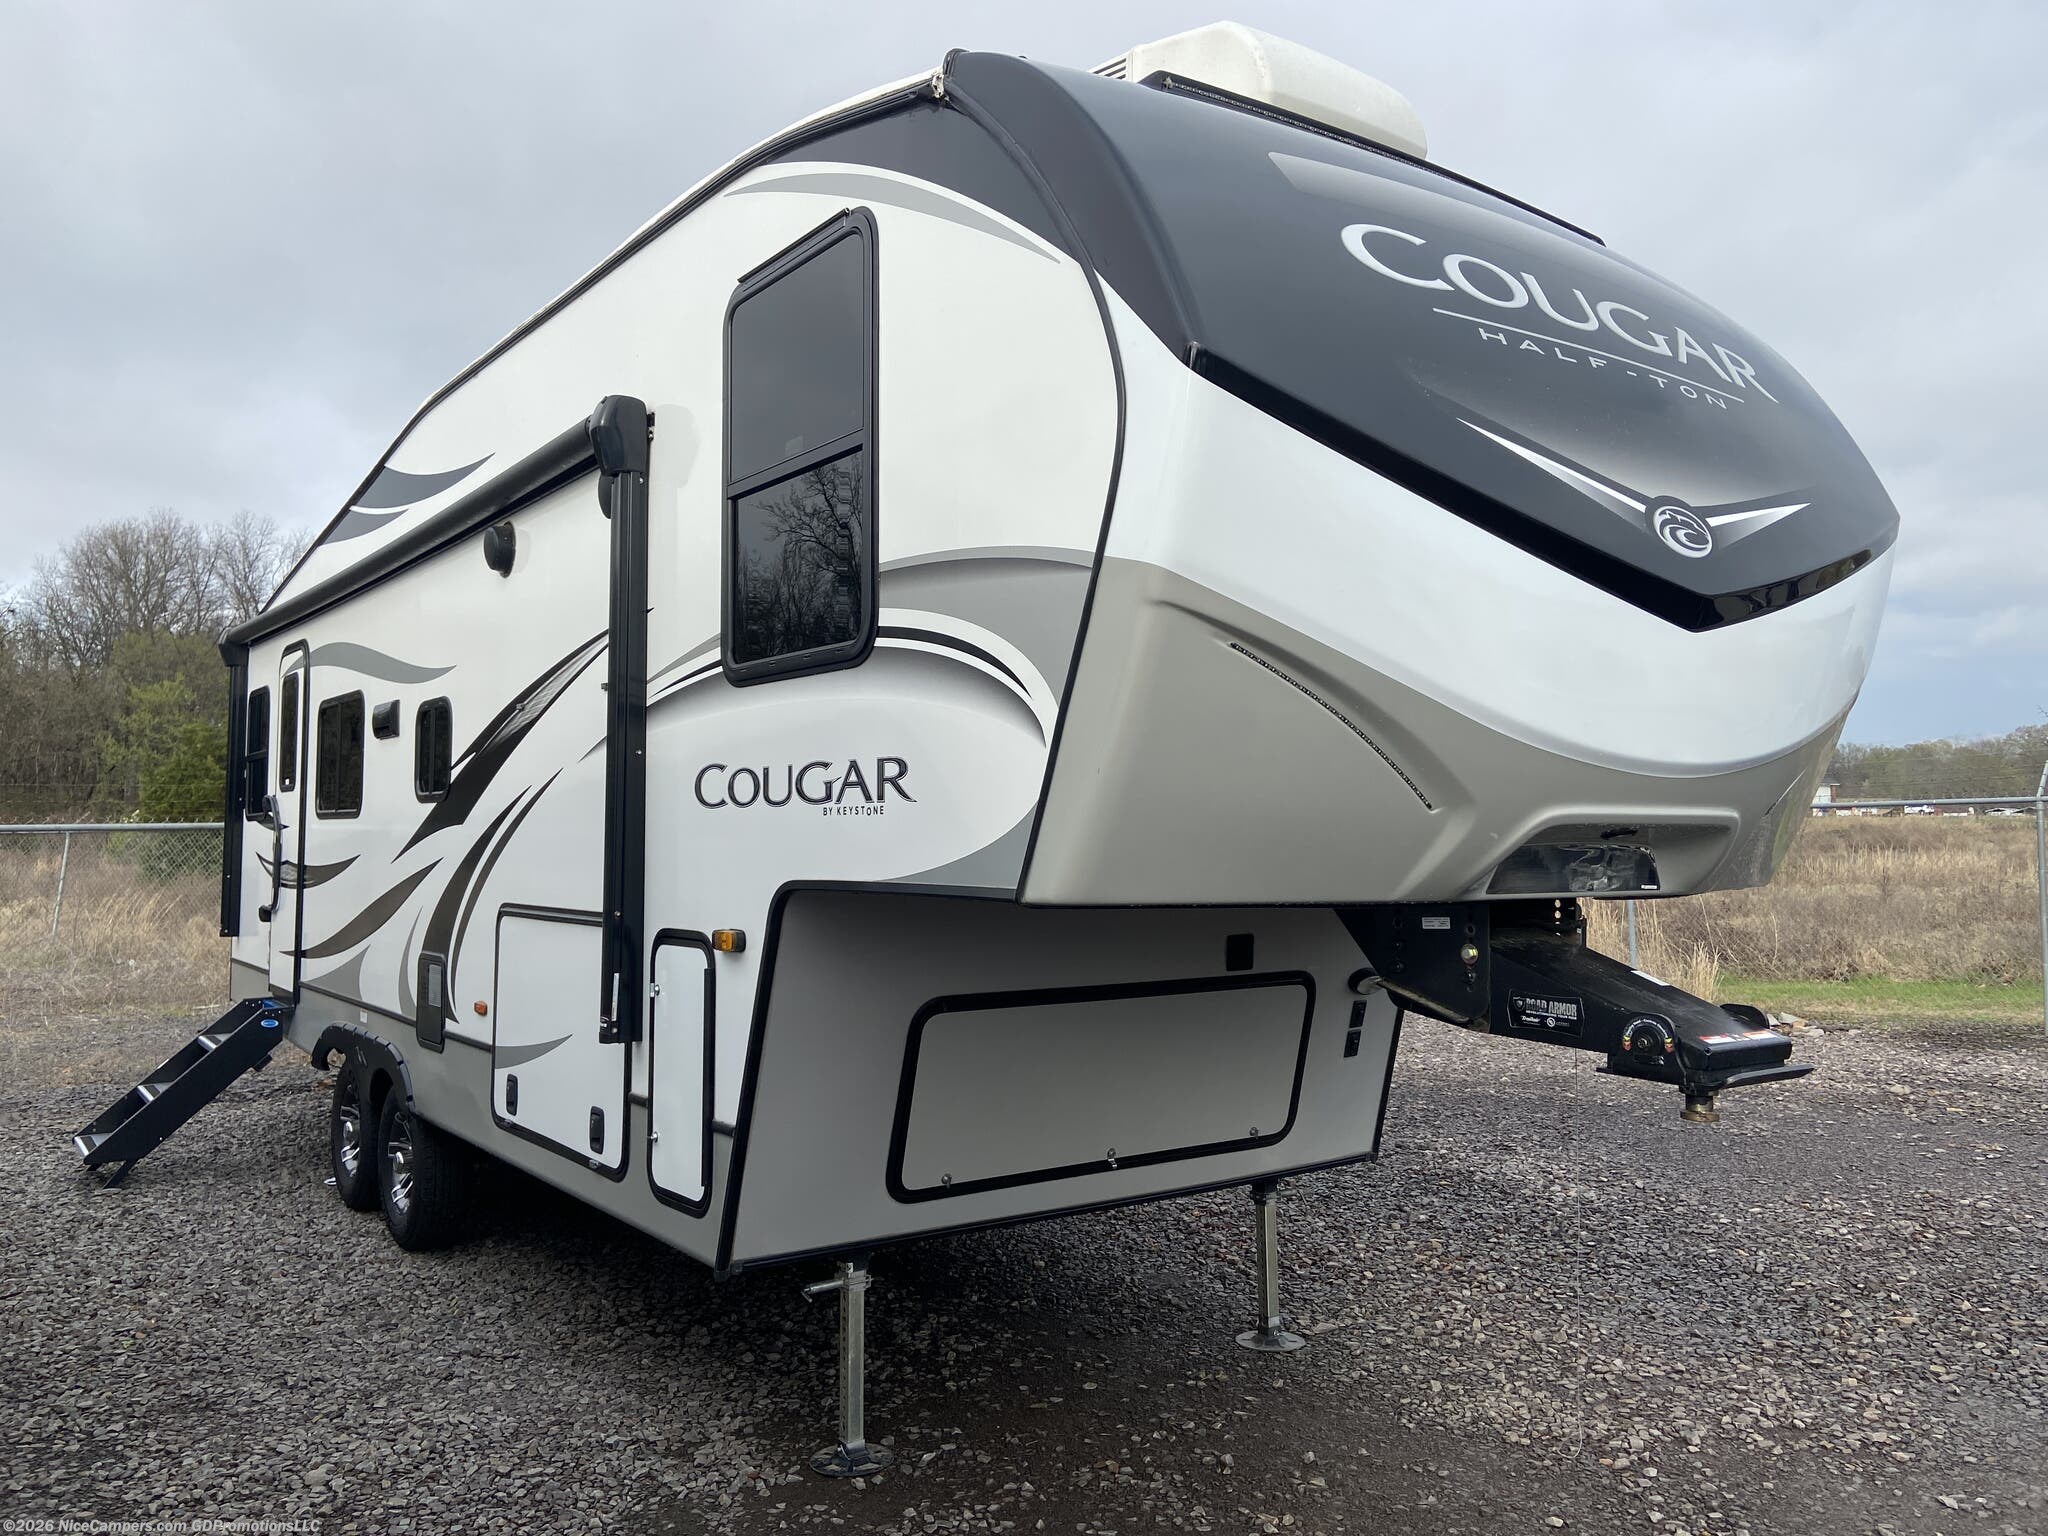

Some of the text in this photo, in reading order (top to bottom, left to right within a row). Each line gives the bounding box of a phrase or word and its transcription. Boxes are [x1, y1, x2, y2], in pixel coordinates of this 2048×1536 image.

[1340, 223, 1779, 404] COUGAR
[1478, 327, 1728, 410] HALF-TON
[694, 756, 918, 810] COUGAR
[822, 805, 885, 817] BY KEYSTONE
[1548, 1001, 1577, 1016] ARMOR
